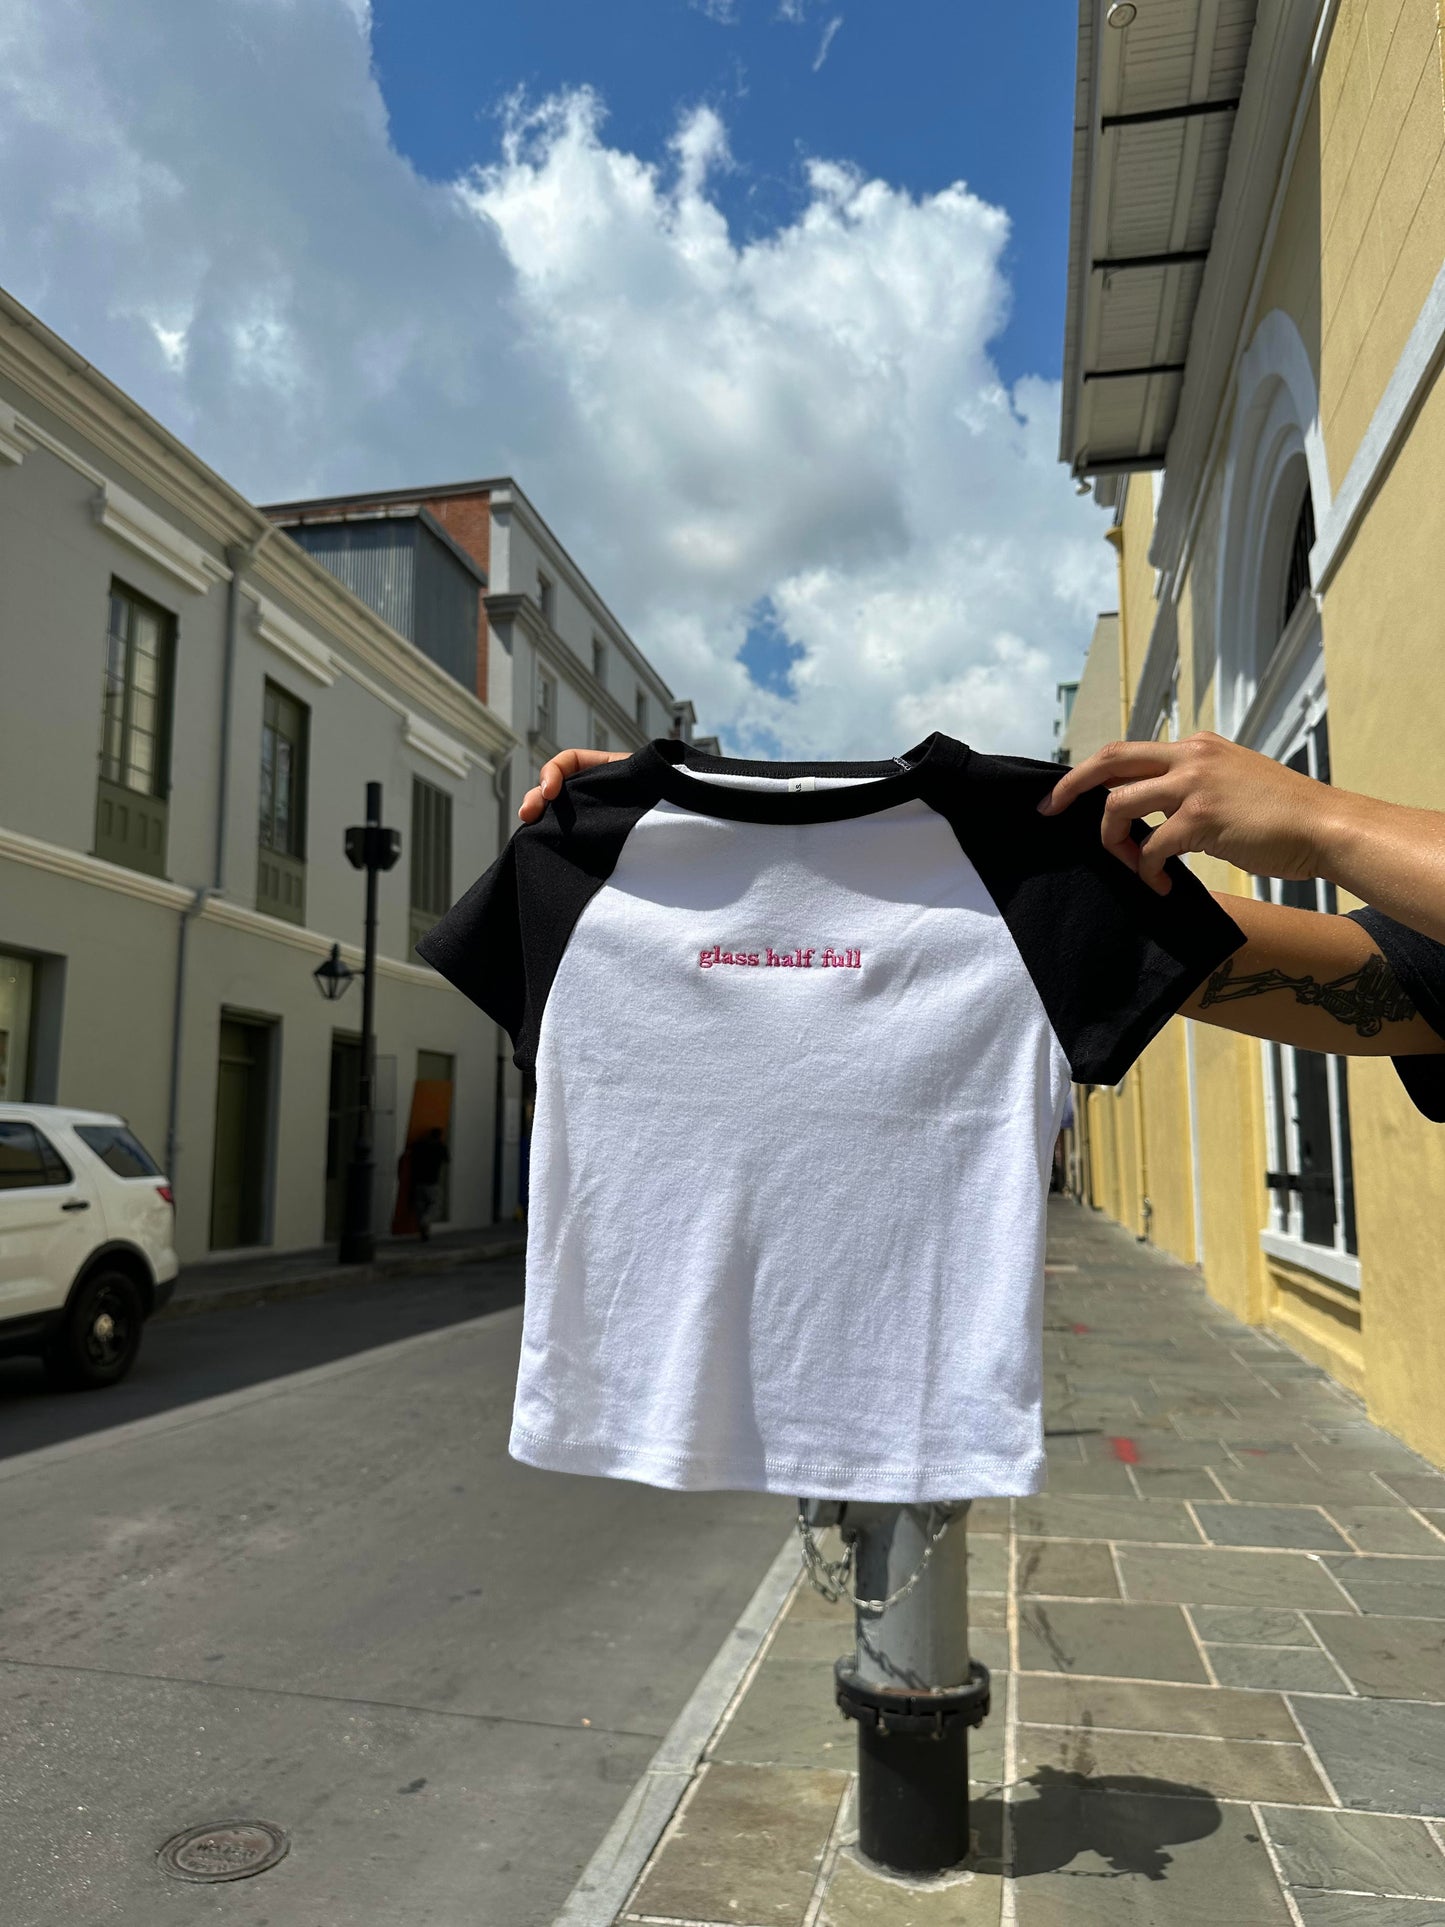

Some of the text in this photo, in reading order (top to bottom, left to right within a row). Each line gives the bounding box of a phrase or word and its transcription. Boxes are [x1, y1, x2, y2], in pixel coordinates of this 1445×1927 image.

[699, 945, 862, 969] glass half full
